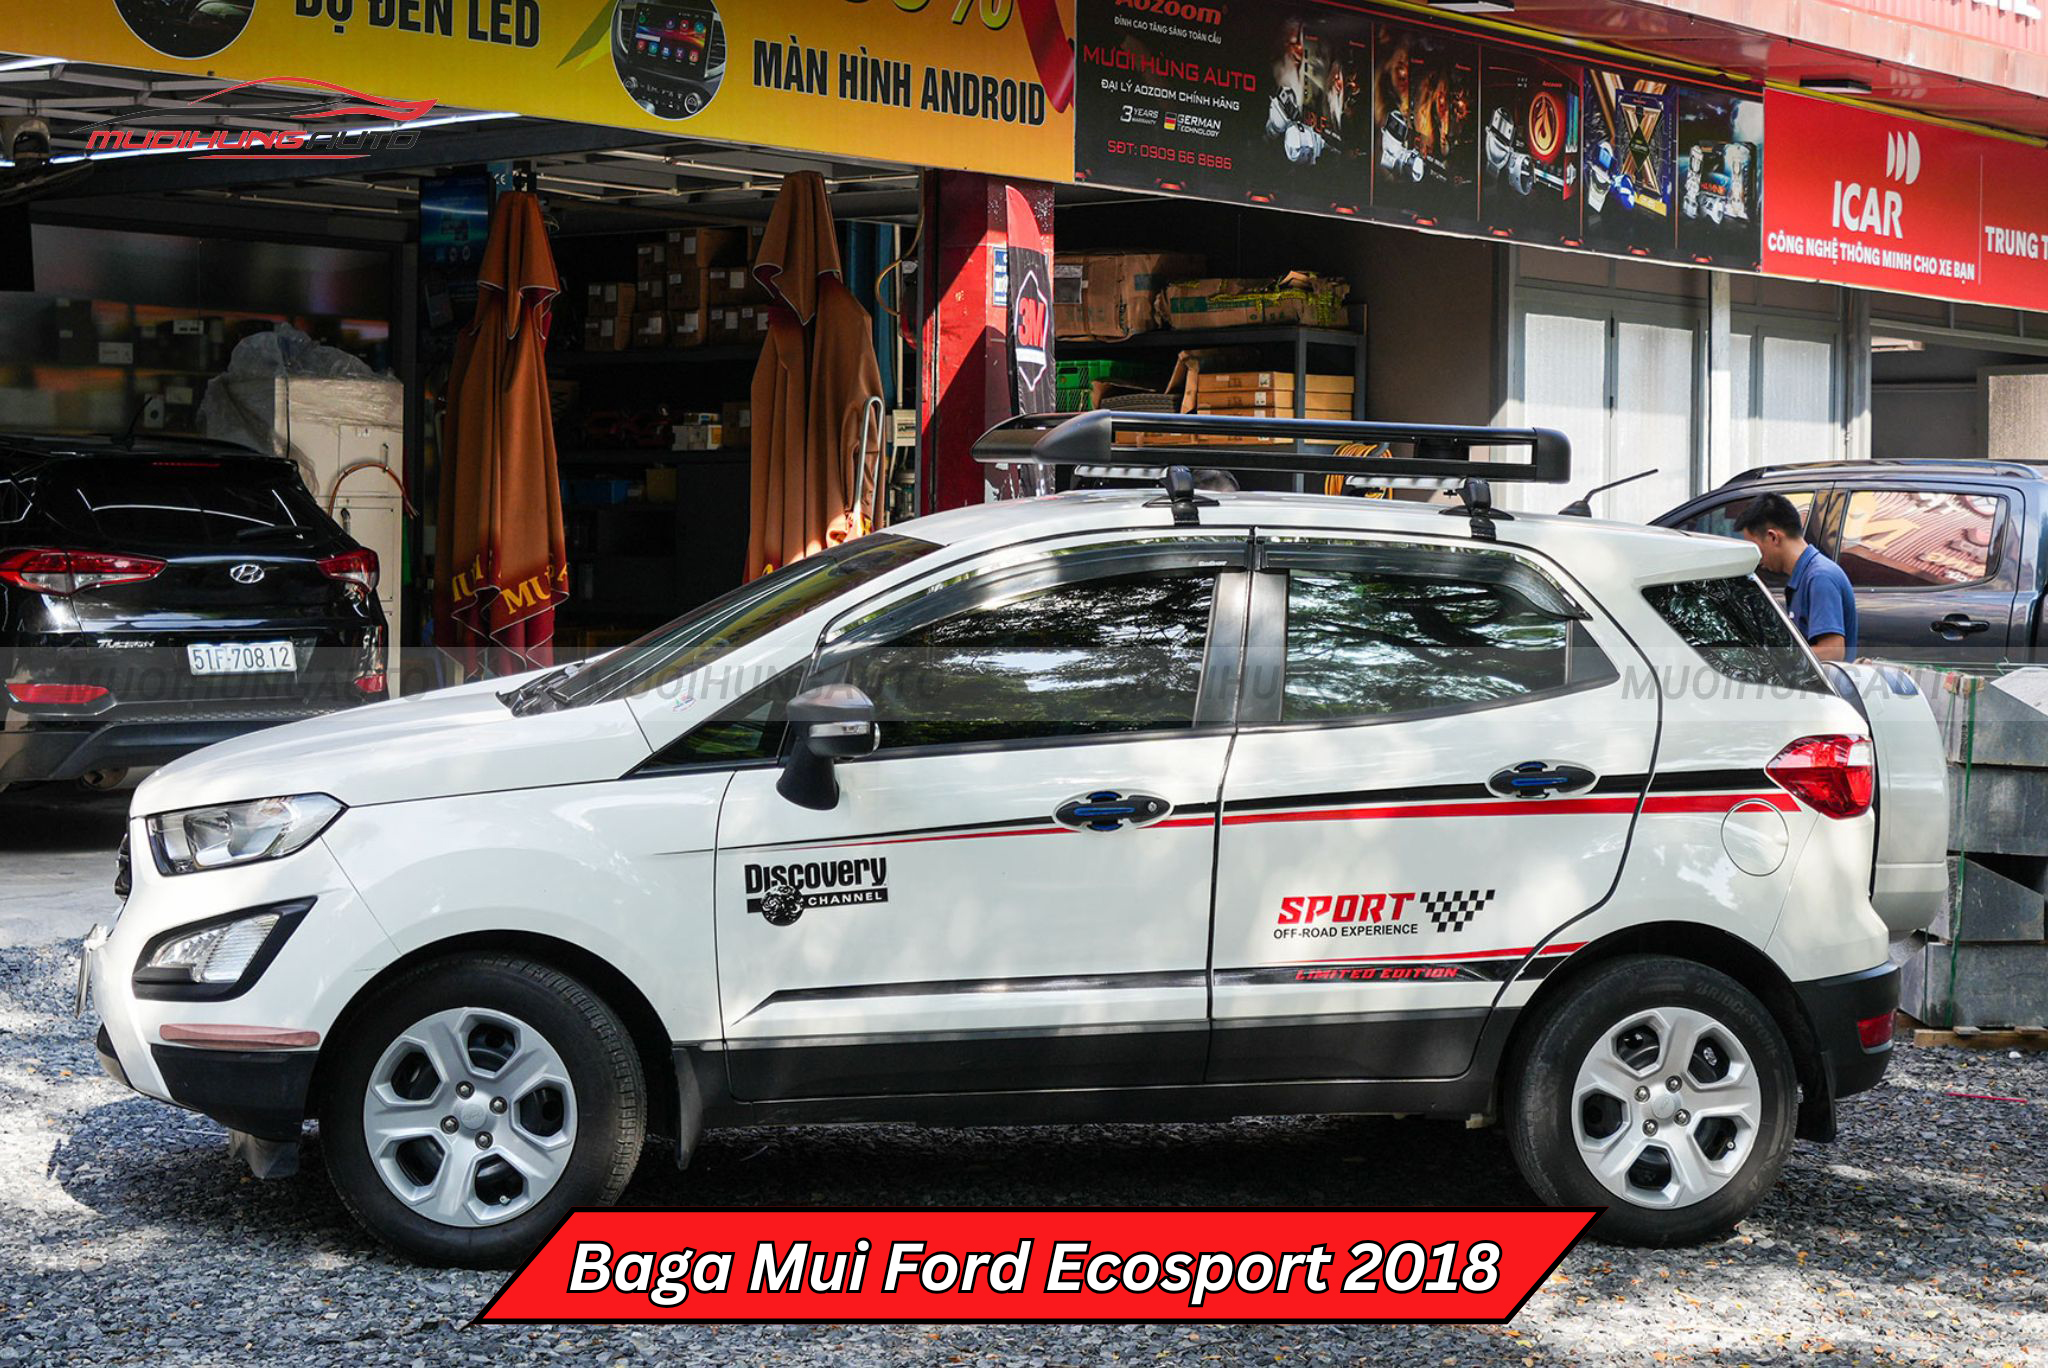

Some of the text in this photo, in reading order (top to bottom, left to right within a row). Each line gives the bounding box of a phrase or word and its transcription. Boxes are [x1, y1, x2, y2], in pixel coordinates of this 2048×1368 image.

[468, 0, 541, 49] LED
[753, 34, 828, 96] MÀN
[838, 45, 911, 109] HÌNH
[920, 66, 1046, 127] ANDROID
[1101, 78, 1118, 93] ĐẠI
[1120, 79, 1132, 93] LÝ
[1134, 84, 1177, 101] AOZOOM
[1178, 90, 1211, 106] CHÍNH
[1203, 66, 1257, 92] AUTO
[1120, 105, 1159, 123] 3 YEARS
[1177, 114, 1222, 130] GERMAN
[1140, 144, 1176, 161] 0909
[1832, 180, 1904, 240] ICAR
[1985, 225, 2038, 259] TRUNG
[1767, 229, 1975, 285] CÔNG NGHỆ THÔNG MINH CHO XE BẠN
[1018, 297, 1046, 349] 3M
[192, 646, 291, 670] 51F-708.12
[807, 892, 883, 906] CHANNEL
[1278, 892, 1416, 925] SPORT
[1274, 923, 1418, 940] OFF-ROAD EXPERIENCE
[1295, 967, 1459, 981] LIMITED EDITION
